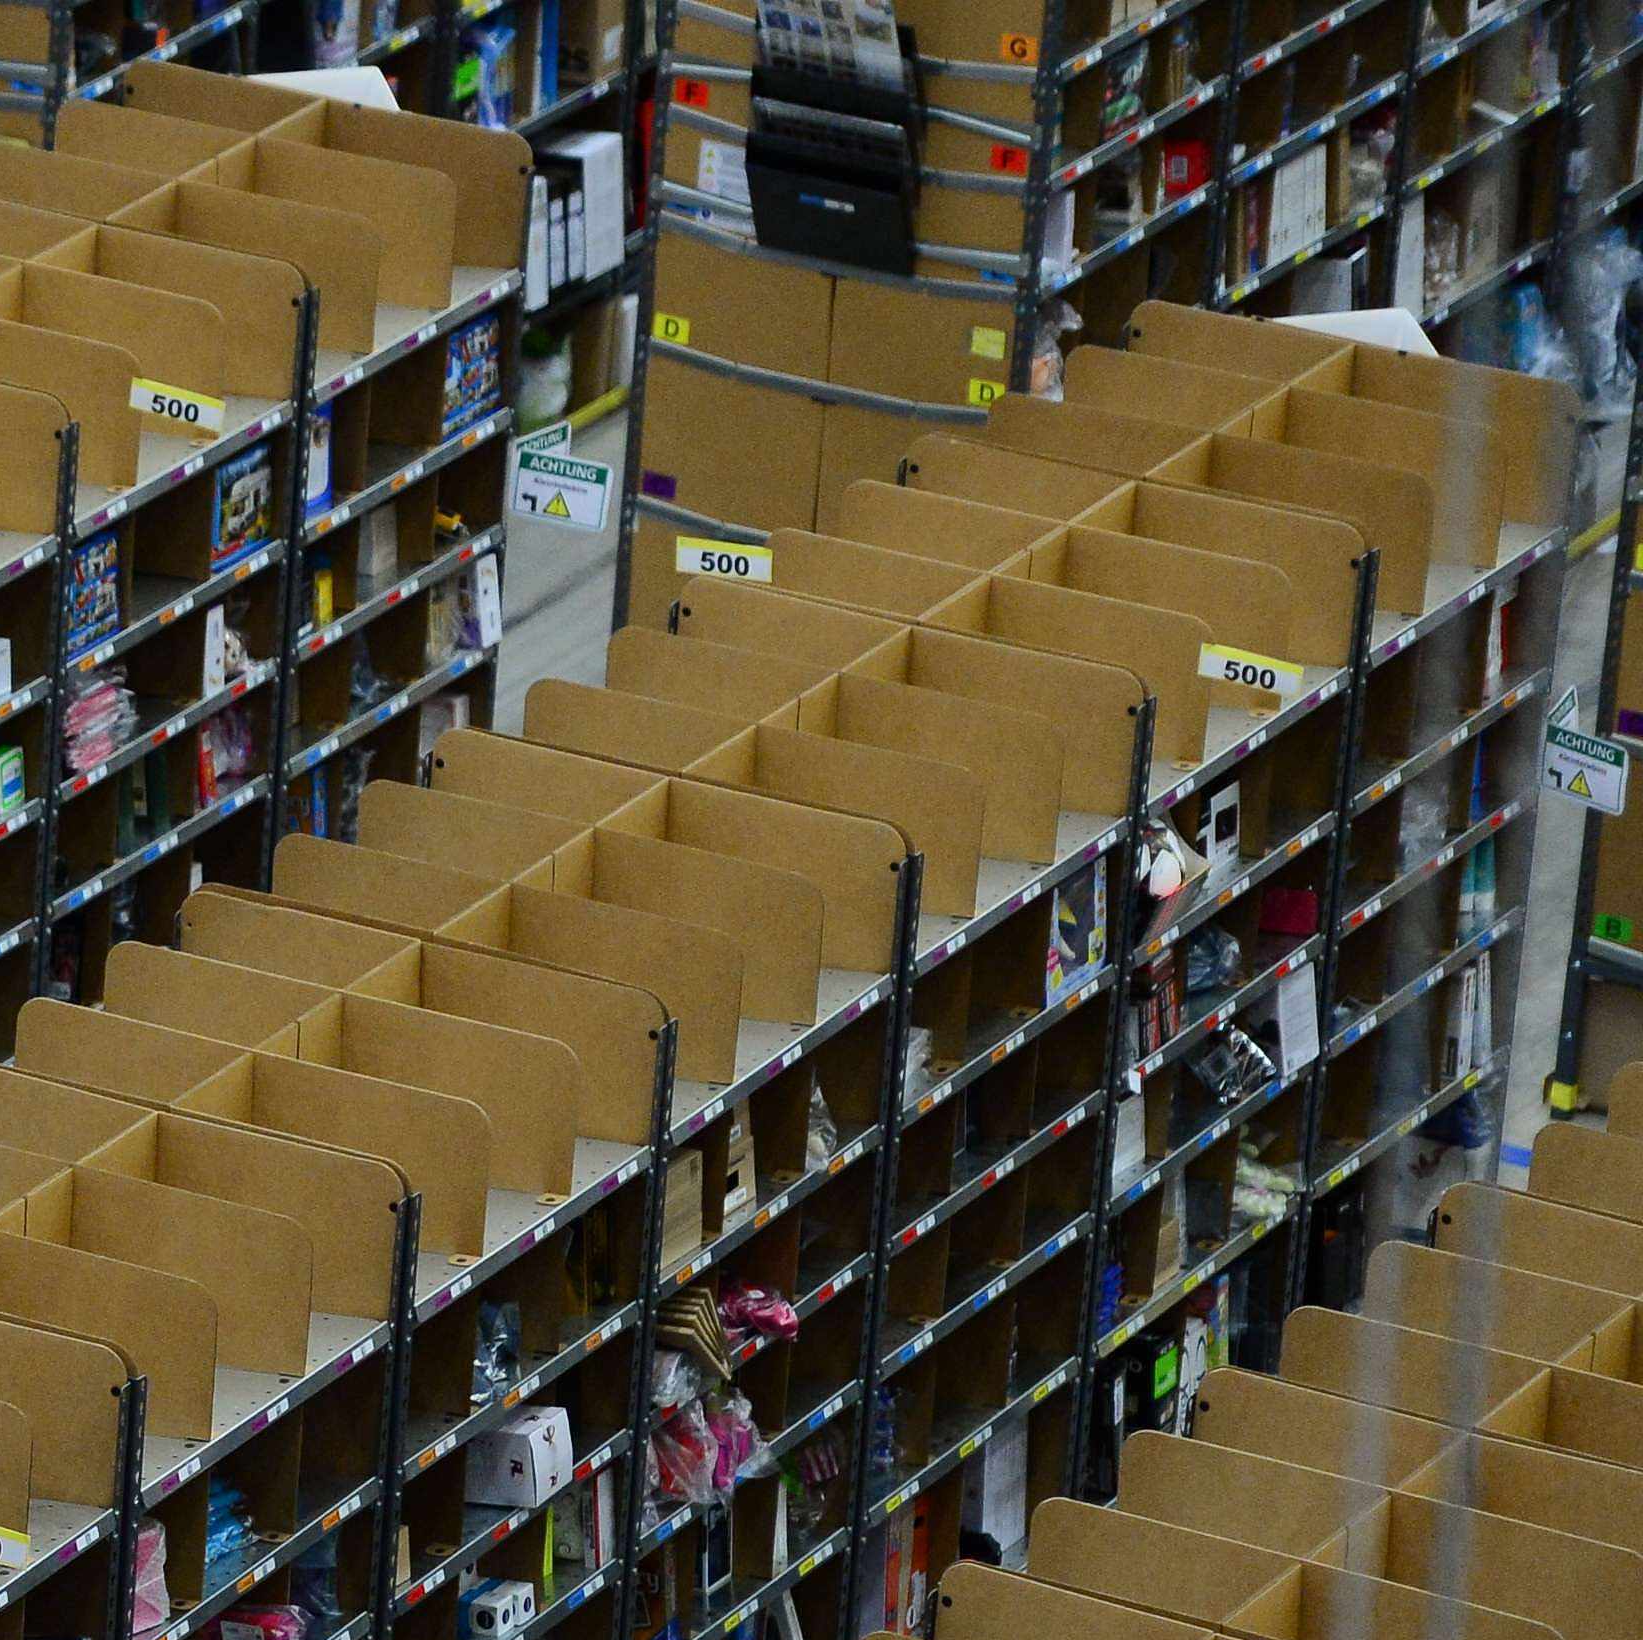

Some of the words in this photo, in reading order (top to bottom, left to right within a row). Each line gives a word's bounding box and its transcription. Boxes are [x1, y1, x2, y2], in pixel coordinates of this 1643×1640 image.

[1010, 37, 1027, 58] G
[1002, 149, 1018, 168] F
[664, 318, 679, 337] D
[980, 383, 995, 402] D
[152, 395, 198, 422] 500
[530, 455, 597, 483] ACHTUNG
[701, 552, 749, 576] 500
[1225, 661, 1275, 690] 500
[1556, 731, 1615, 763] ACHTUNG
[1606, 918, 1622, 937] B
